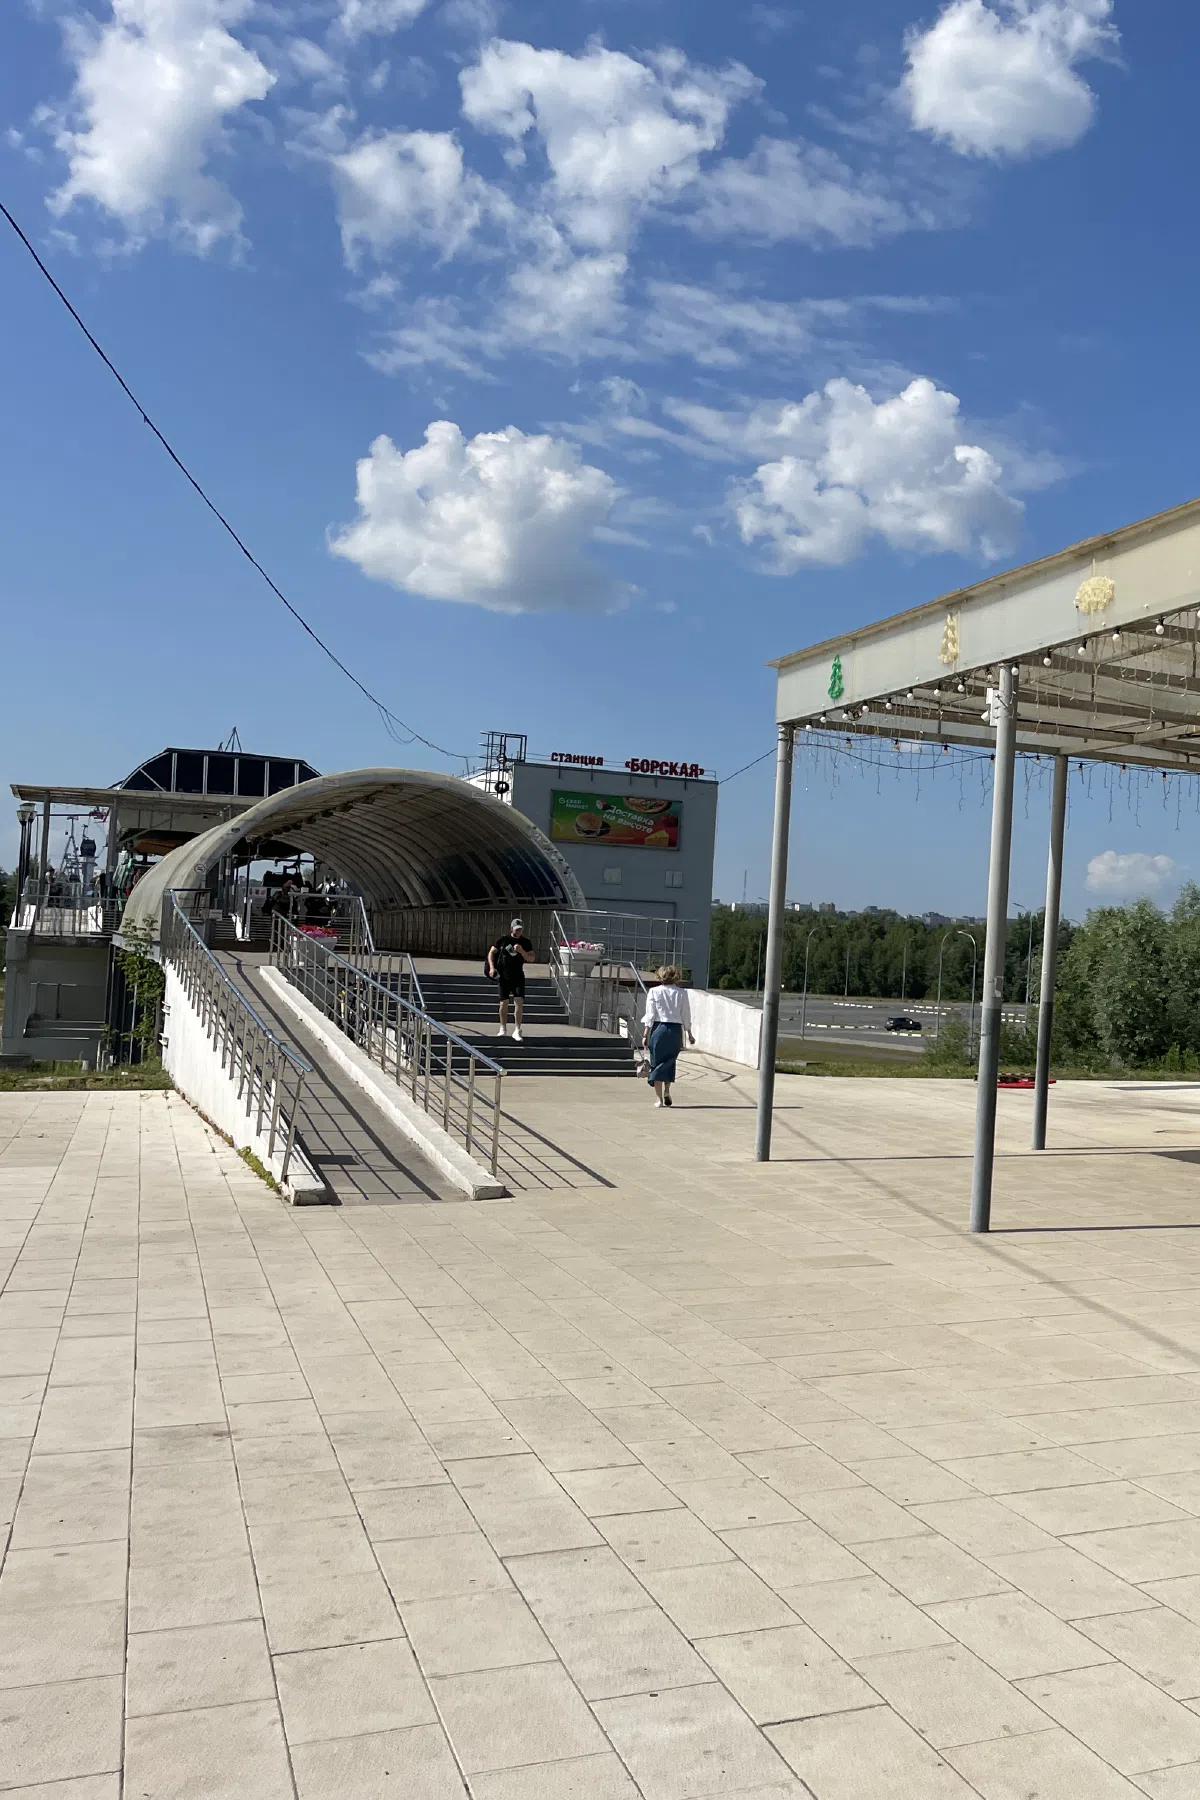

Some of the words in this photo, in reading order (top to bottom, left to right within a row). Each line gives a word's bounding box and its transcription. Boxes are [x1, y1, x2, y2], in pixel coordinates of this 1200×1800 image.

[551, 752, 604, 766] станция
[625, 758, 705, 777] «БОРСКАЯ»
[603, 813, 616, 821] на
[617, 818, 654, 834] высоте
[606, 805, 655, 826] Доставка
